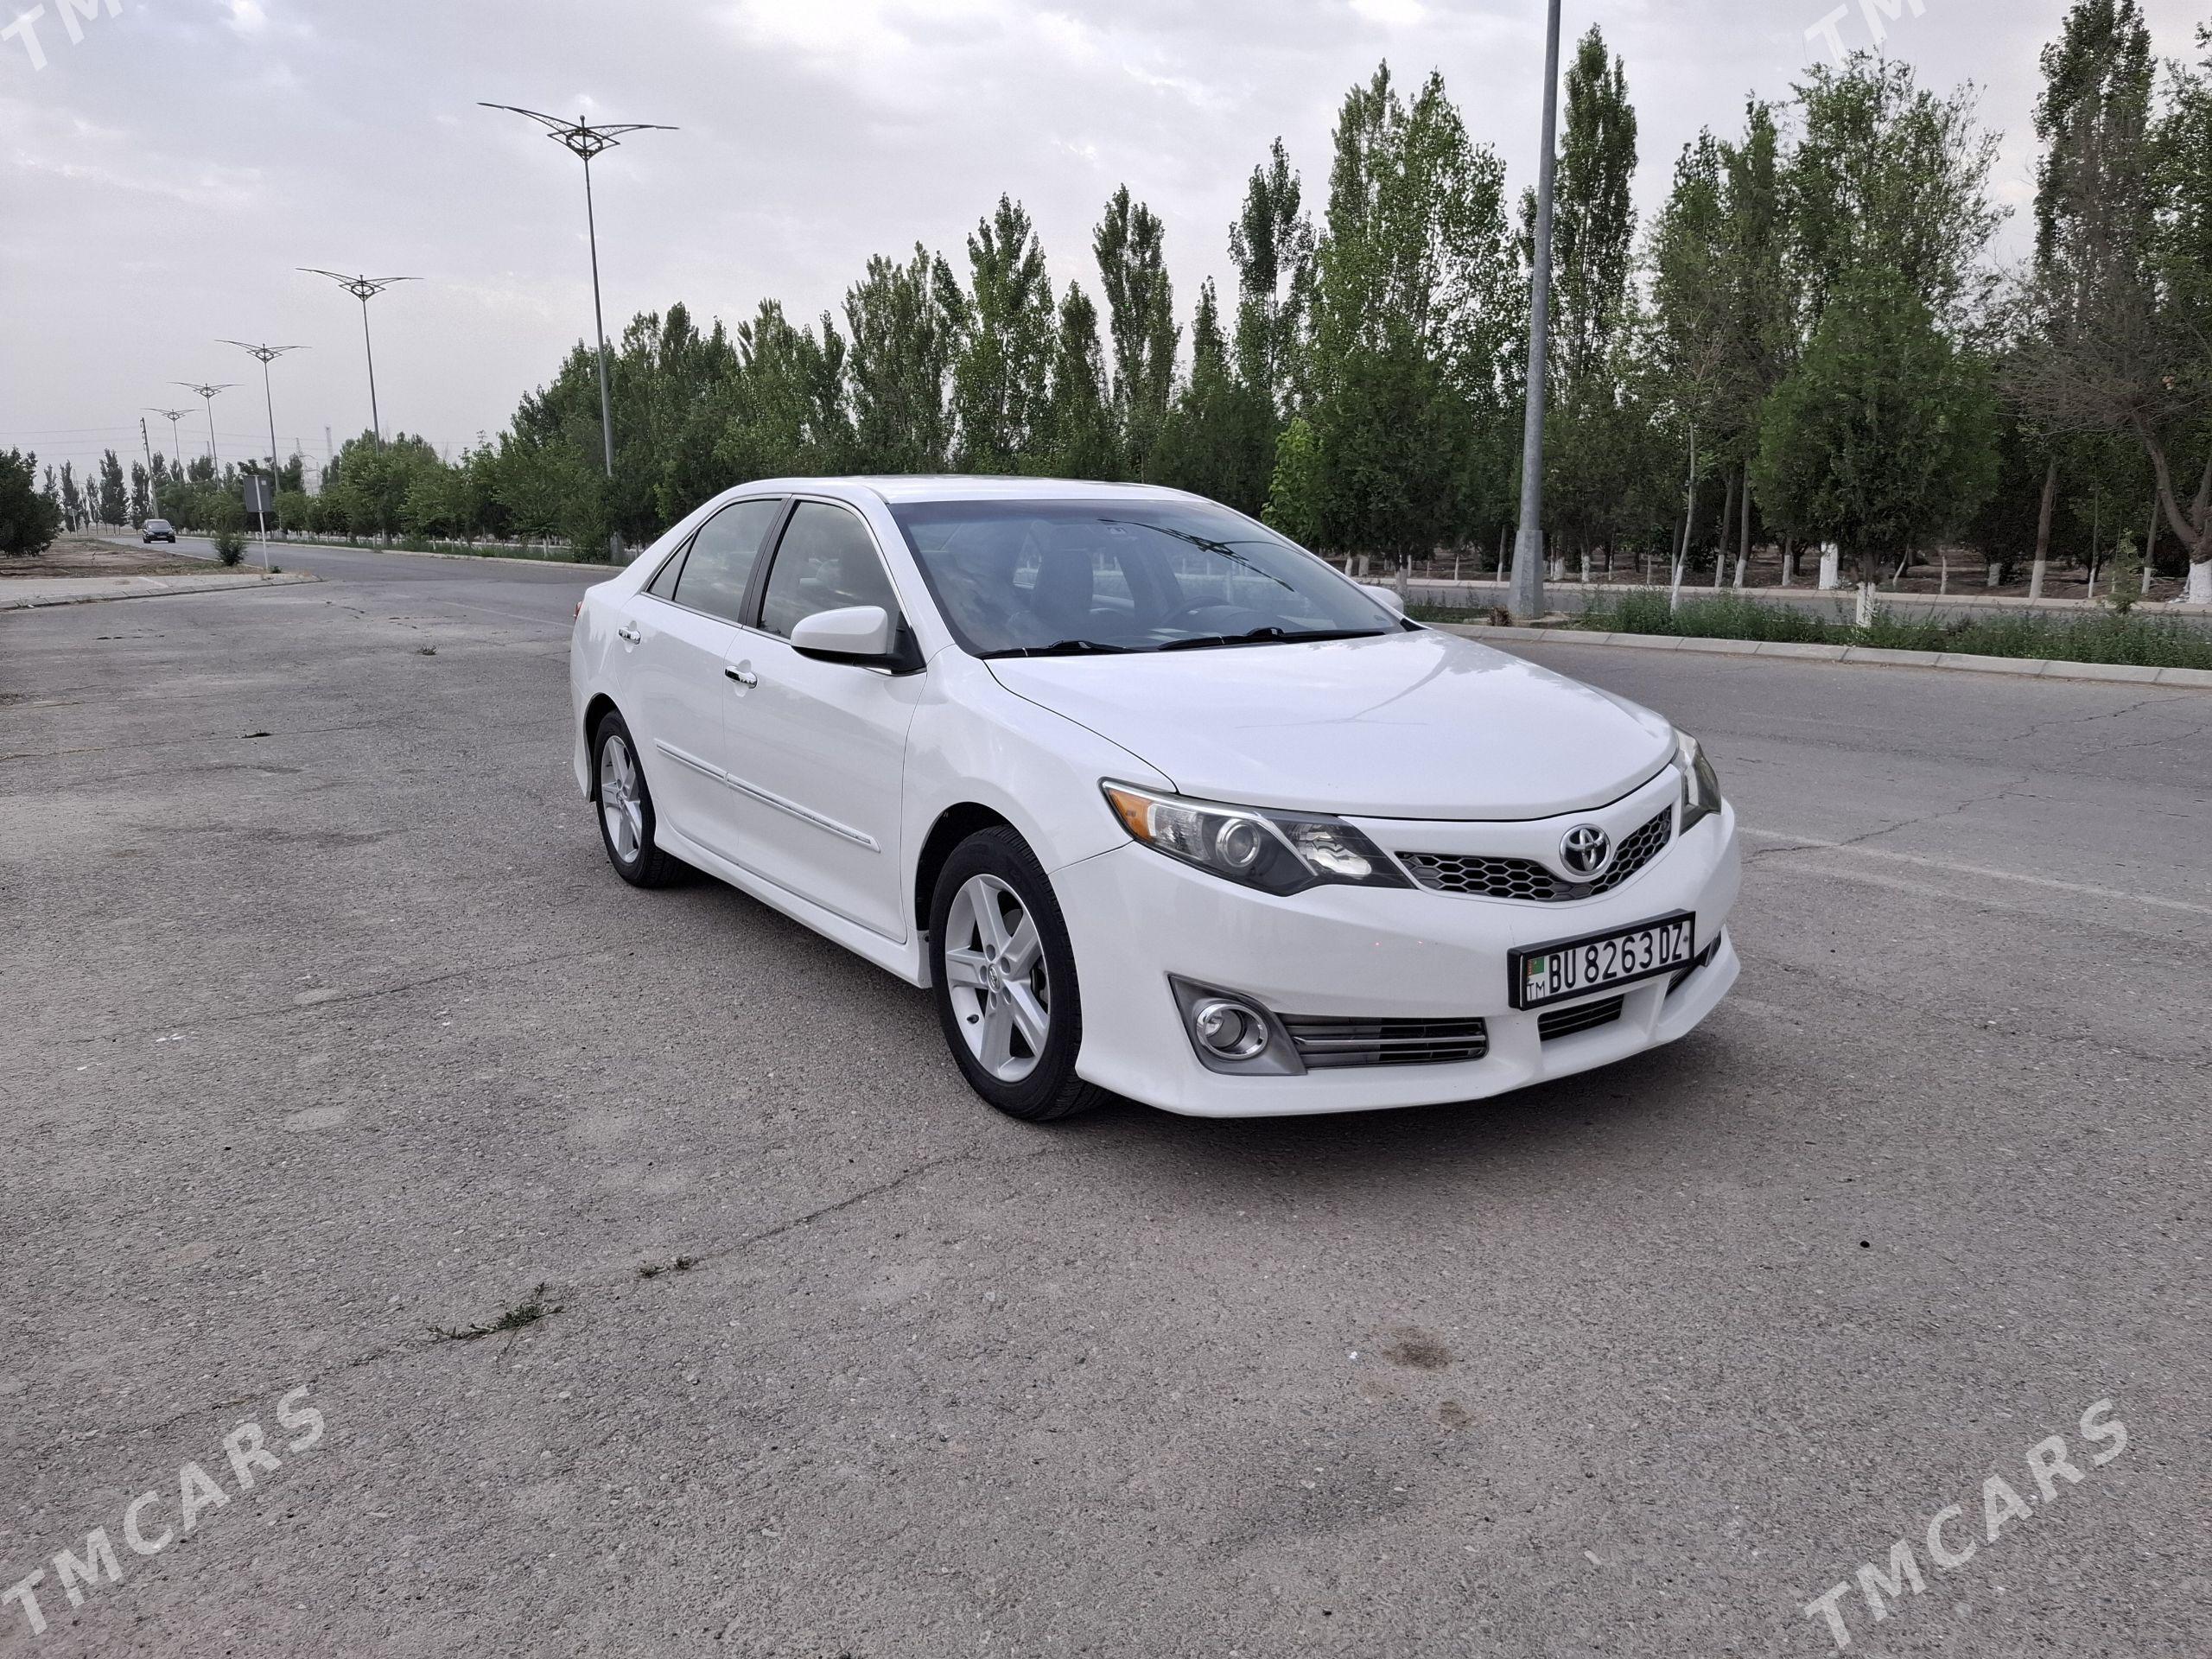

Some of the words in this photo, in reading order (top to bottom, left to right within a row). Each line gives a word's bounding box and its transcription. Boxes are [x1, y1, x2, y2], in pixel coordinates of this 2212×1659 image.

[1549, 950, 1577, 994] BU
[1585, 931, 1654, 983] 8263
[1660, 924, 1683, 964] DZ
[1527, 980, 1546, 1000] TM
